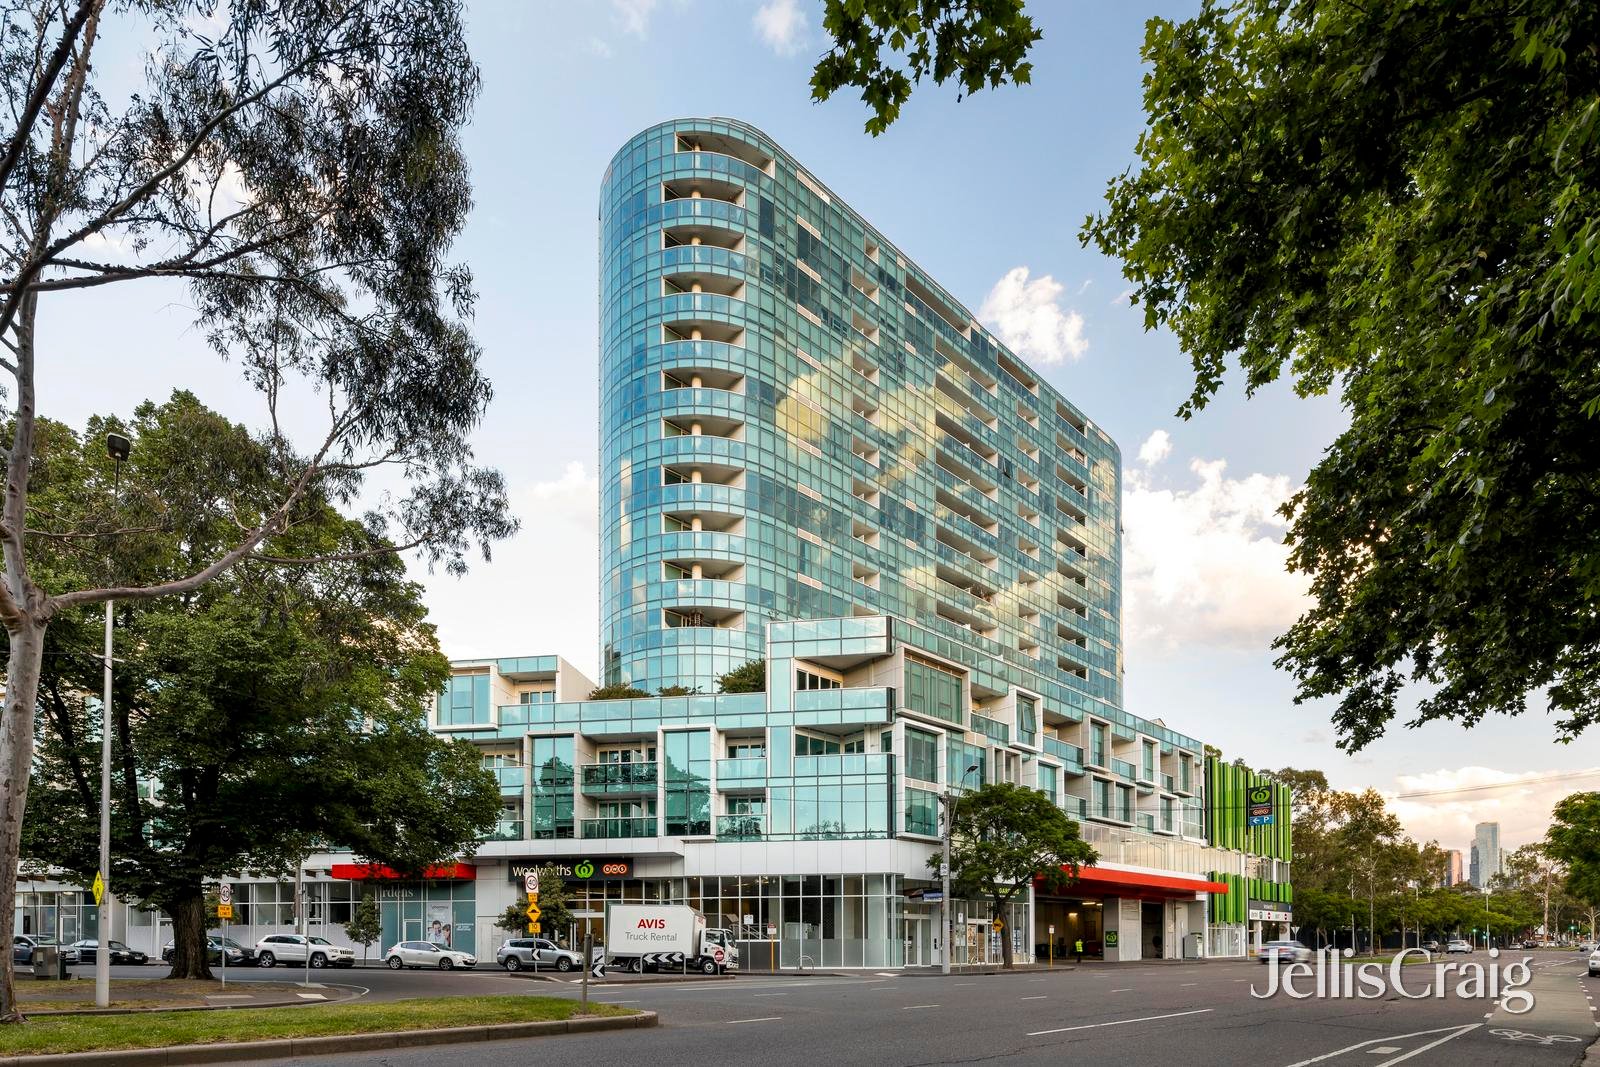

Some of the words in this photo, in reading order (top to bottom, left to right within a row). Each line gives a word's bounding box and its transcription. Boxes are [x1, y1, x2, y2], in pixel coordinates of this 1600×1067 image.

[512, 863, 572, 877] woolwoths
[637, 918, 666, 929] AVIS
[625, 931, 649, 941] Truck
[651, 932, 678, 942] Rental
